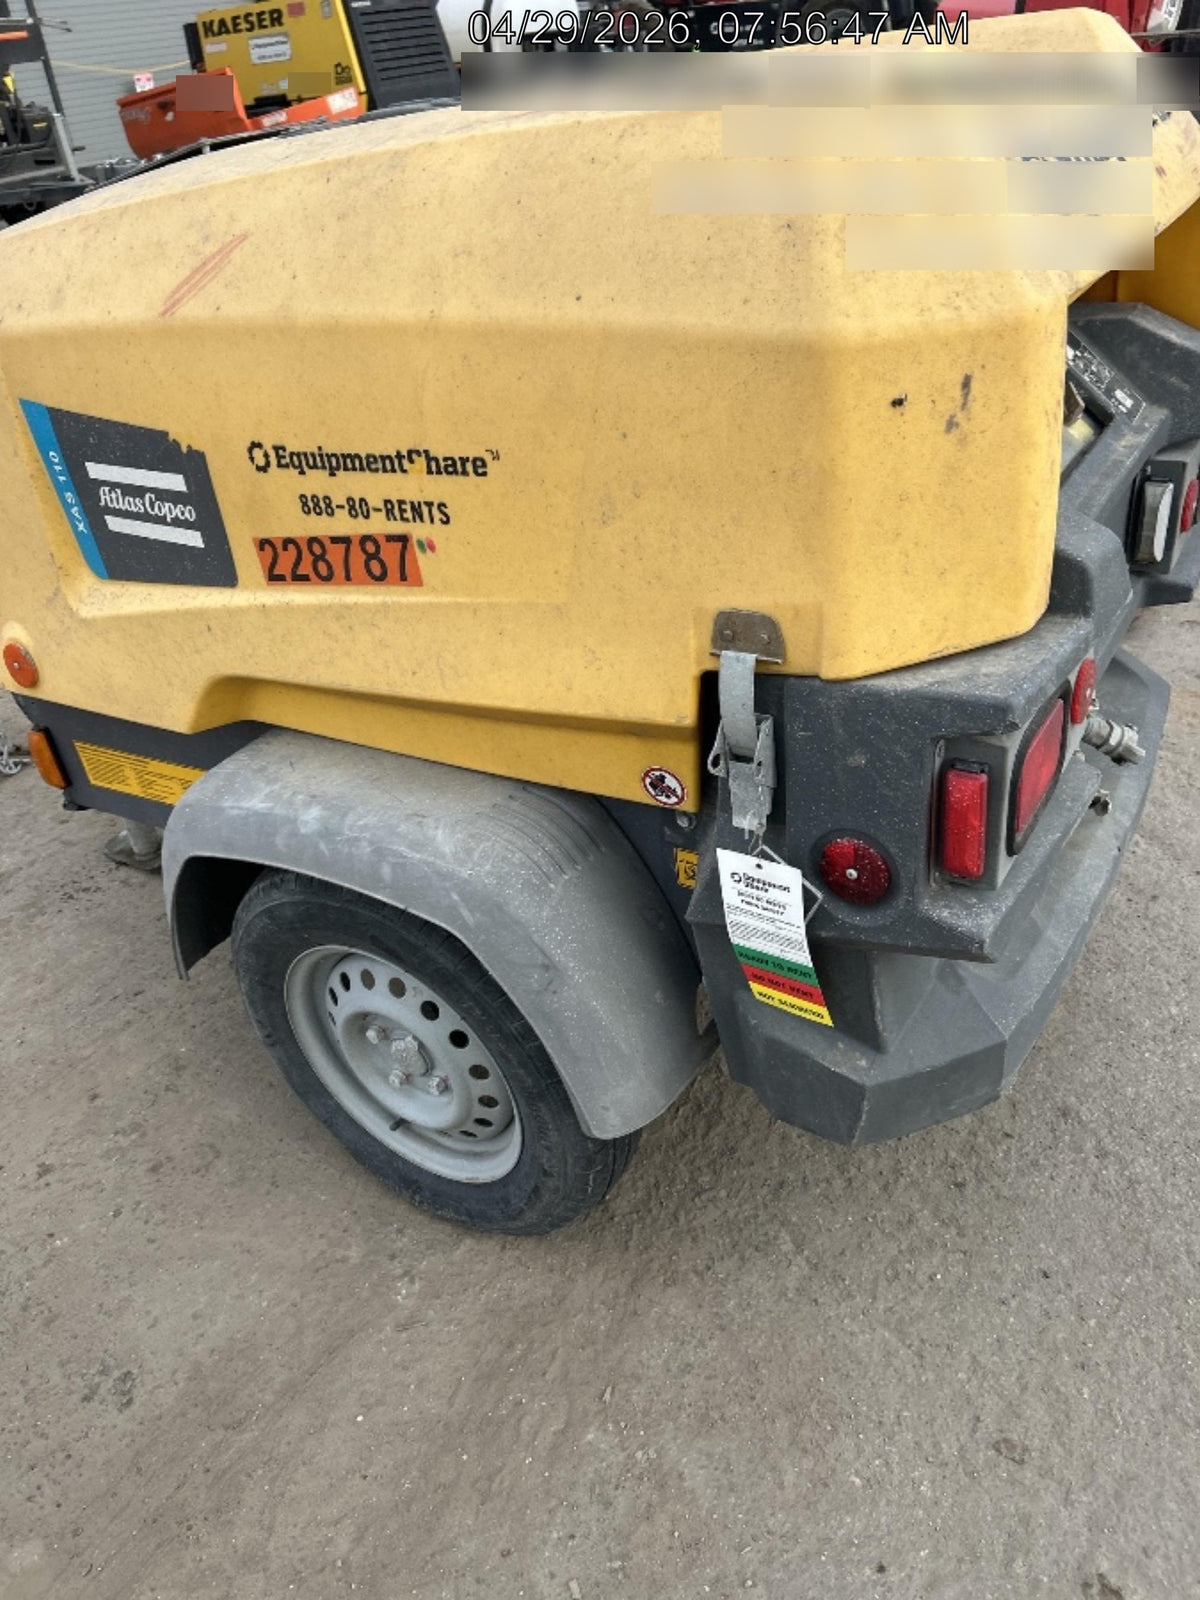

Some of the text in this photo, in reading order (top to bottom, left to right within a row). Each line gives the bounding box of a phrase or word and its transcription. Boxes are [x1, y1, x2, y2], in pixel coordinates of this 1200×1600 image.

[202, 8, 284, 38] KAESER
[49, 451, 88, 534] XAS 110
[99, 486, 196, 522] Atlas Copco
[298, 494, 451, 525] 888-80-RENTS
[258, 534, 410, 583] 228787
